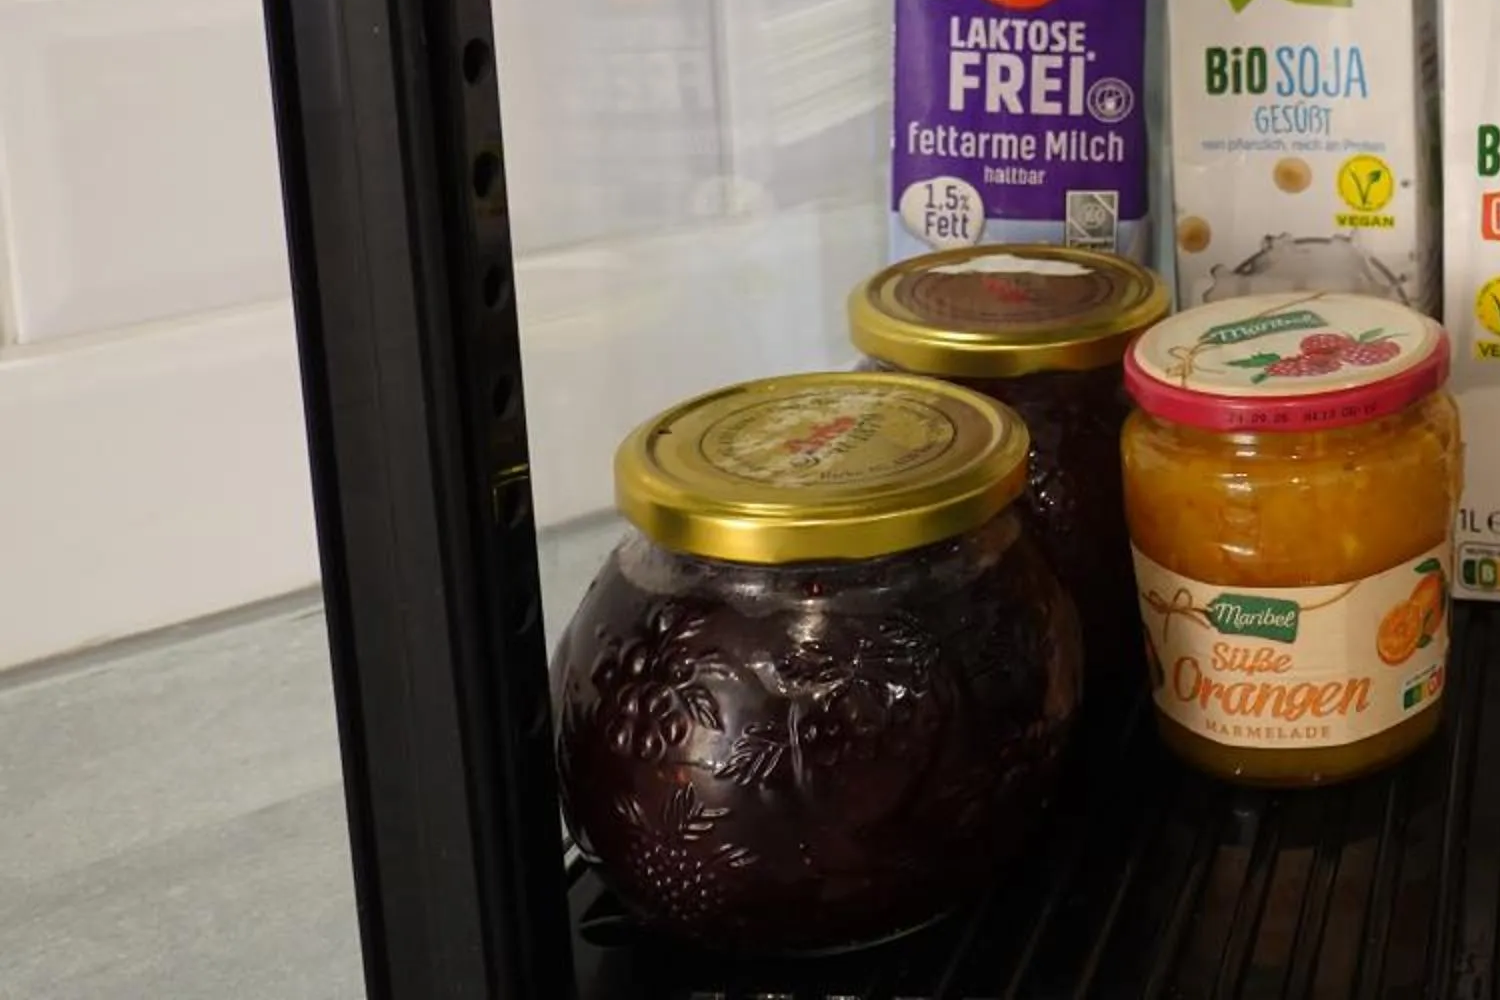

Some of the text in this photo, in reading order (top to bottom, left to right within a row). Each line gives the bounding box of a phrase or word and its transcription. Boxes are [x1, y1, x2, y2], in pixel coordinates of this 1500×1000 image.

[950, 16, 1087, 52] LAKTOSE
[1274, 45, 1368, 99] SOJA
[908, 121, 1036, 160] fettarme
[1045, 129, 1124, 163] Milch
[983, 164, 1046, 187] haltbar
[924, 211, 969, 240] Fett
[1337, 214, 1395, 229] VEGAN
[1212, 601, 1297, 631] Maribel
[1211, 641, 1293, 678] Süße
[1173, 655, 1372, 723] Orangen
[1204, 719, 1332, 740] MARMELADE
